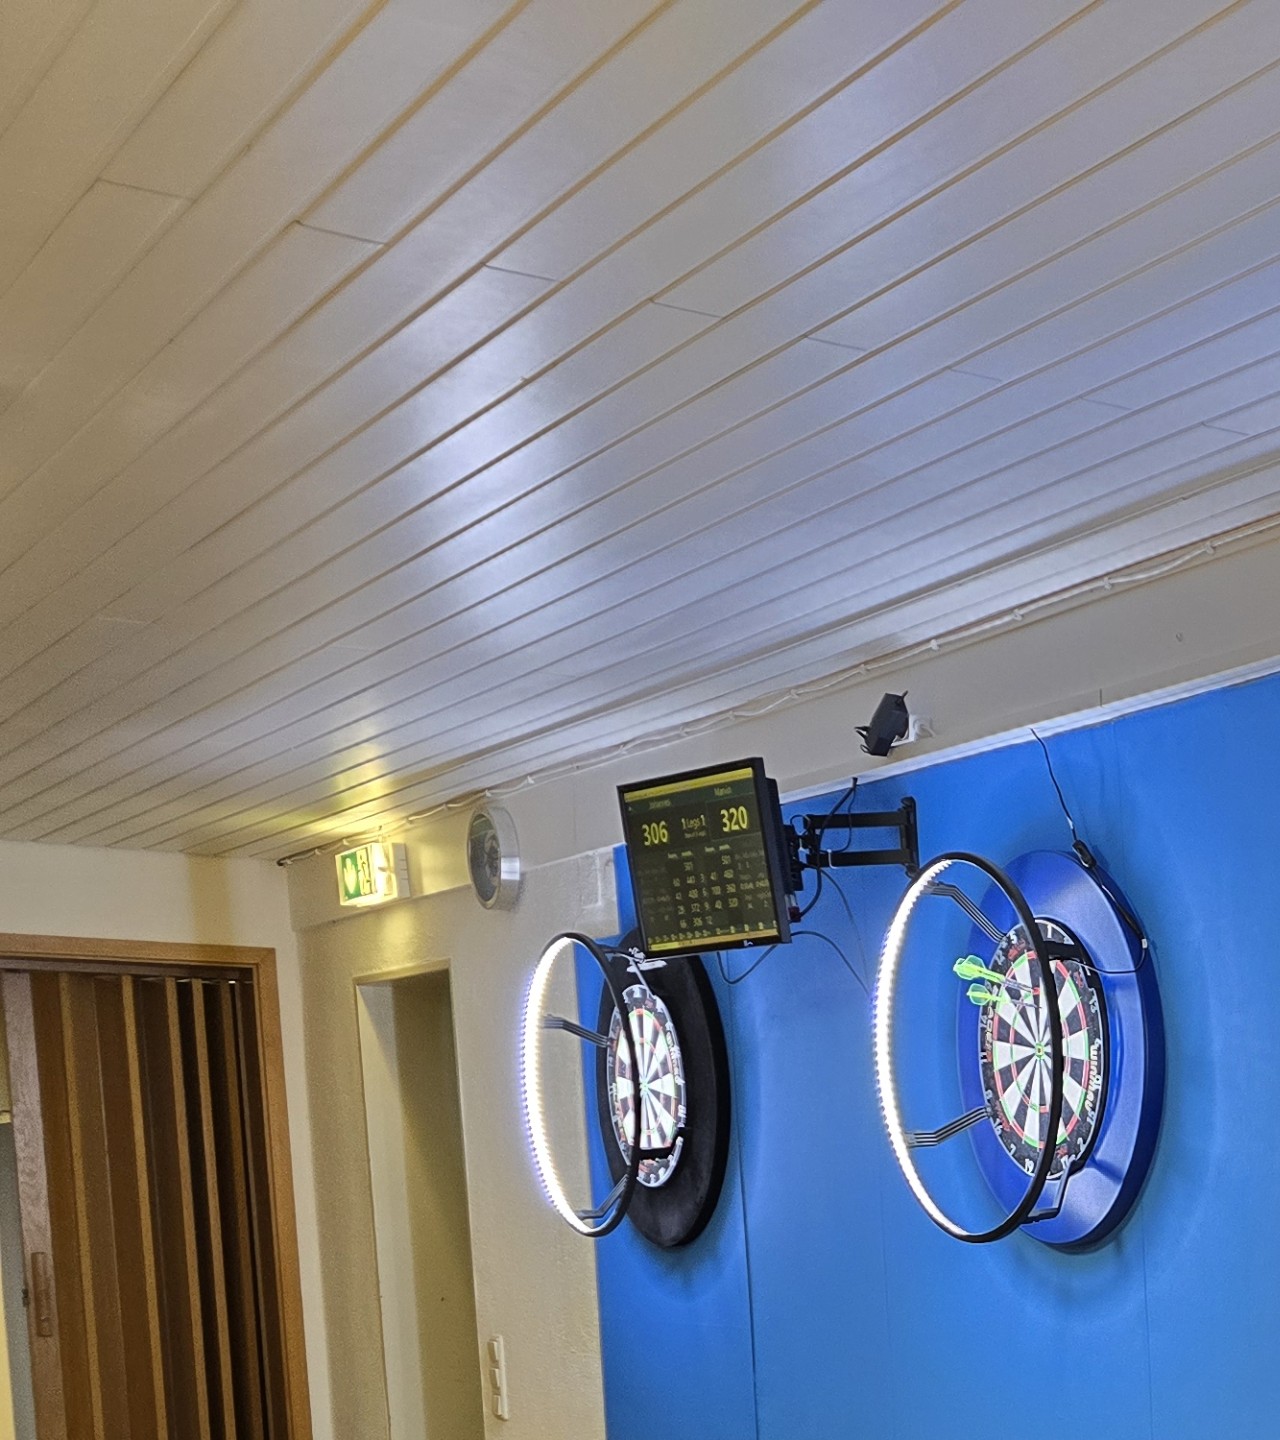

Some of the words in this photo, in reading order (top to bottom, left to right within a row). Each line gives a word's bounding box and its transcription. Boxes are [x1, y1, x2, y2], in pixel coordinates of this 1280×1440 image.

[681, 817, 687, 830] 1
[700, 814, 706, 827] 1
[720, 805, 748, 832] 320
[641, 820, 669, 846] 306
[1010, 930, 1018, 944] 5
